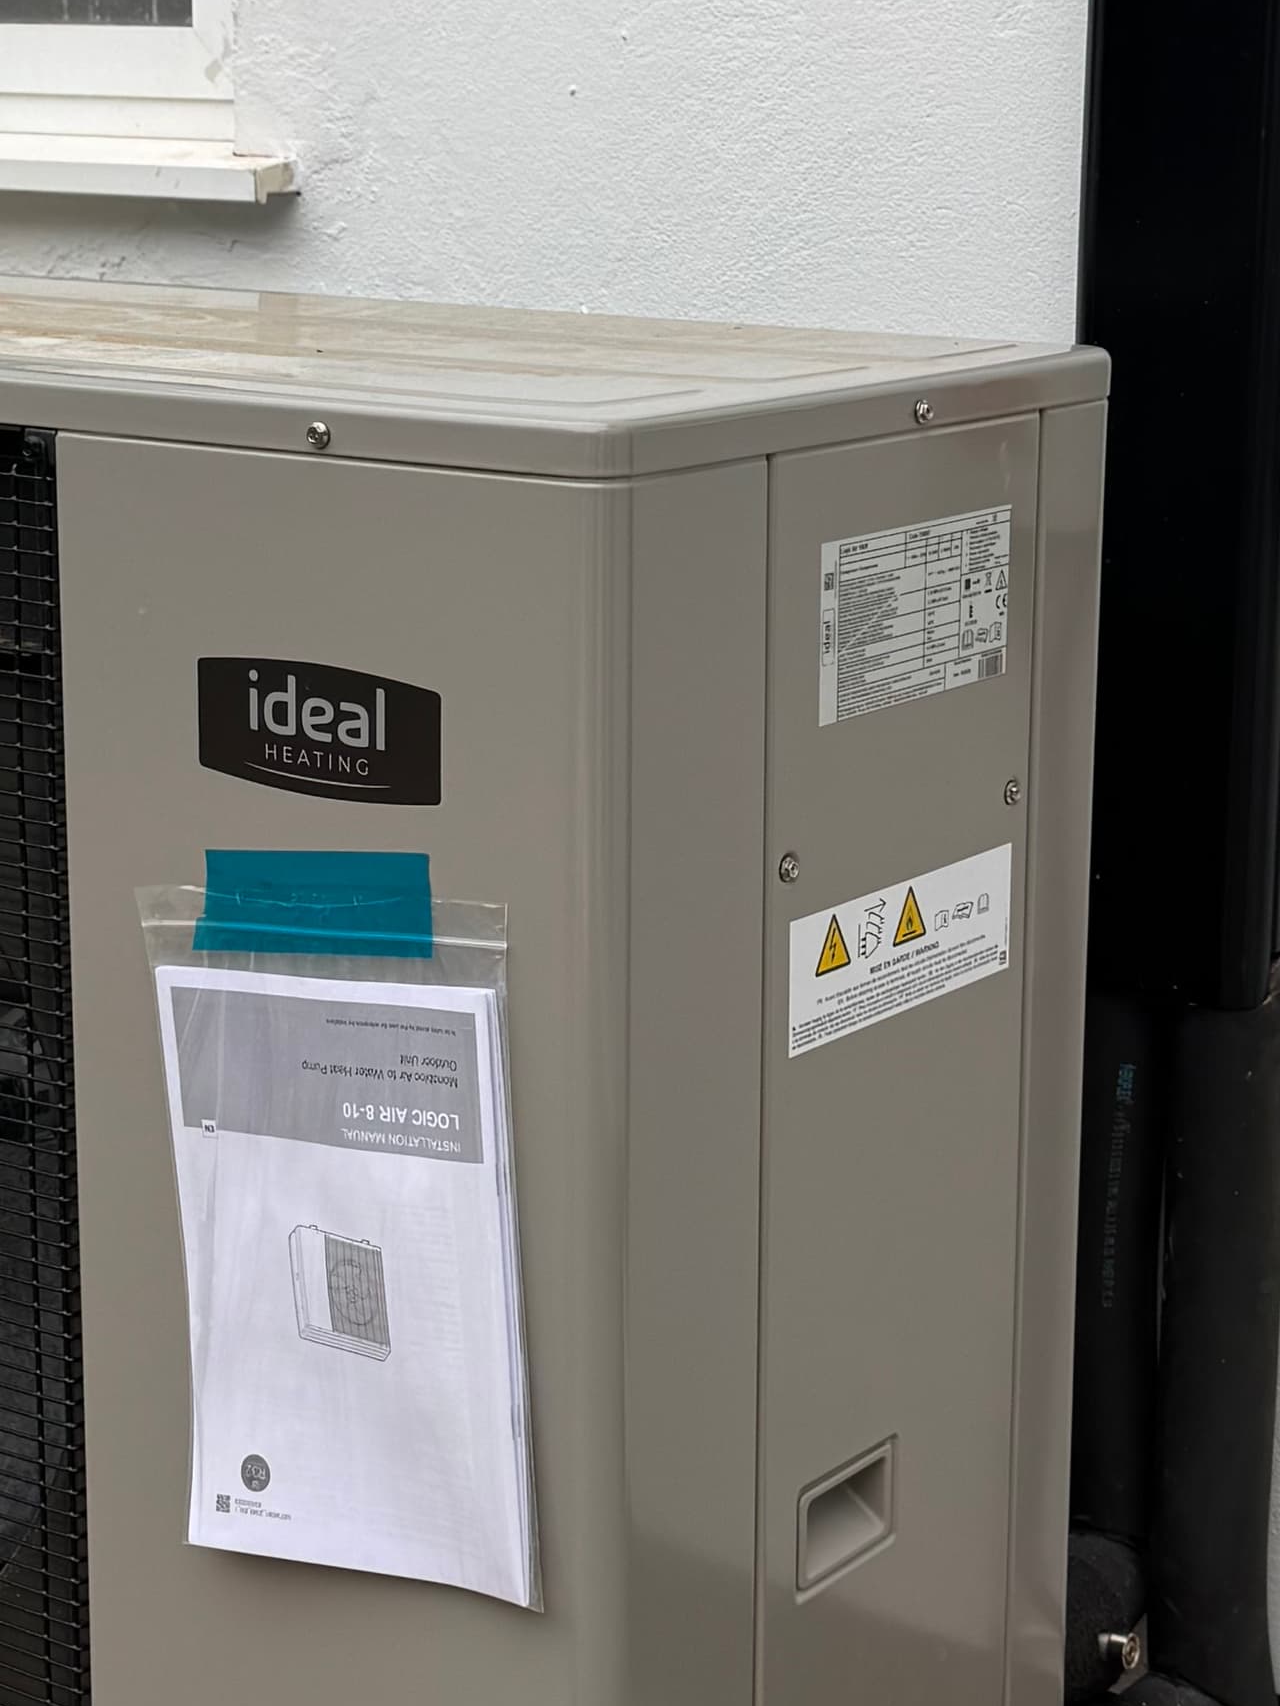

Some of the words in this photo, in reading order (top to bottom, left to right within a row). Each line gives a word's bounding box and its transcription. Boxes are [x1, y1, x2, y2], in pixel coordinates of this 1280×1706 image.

[823, 620, 831, 654] ideal
[249, 668, 386, 751] ideal
[265, 743, 370, 777] HEATING
[302, 1060, 327, 1075] Pump
[399, 1054, 419, 1067] Unit
[420, 1056, 457, 1071] Outdoor
[329, 1064, 352, 1077] Heat
[355, 1066, 384, 1081] Water
[387, 1069, 397, 1081] to
[399, 1071, 412, 1083] Air
[343, 1102, 375, 1120] 8-10
[378, 1105, 408, 1123] AIR
[411, 1108, 460, 1130] LOGIC
[343, 1128, 386, 1143] MANUAL
[388, 1132, 461, 1153] INSTALLATION
